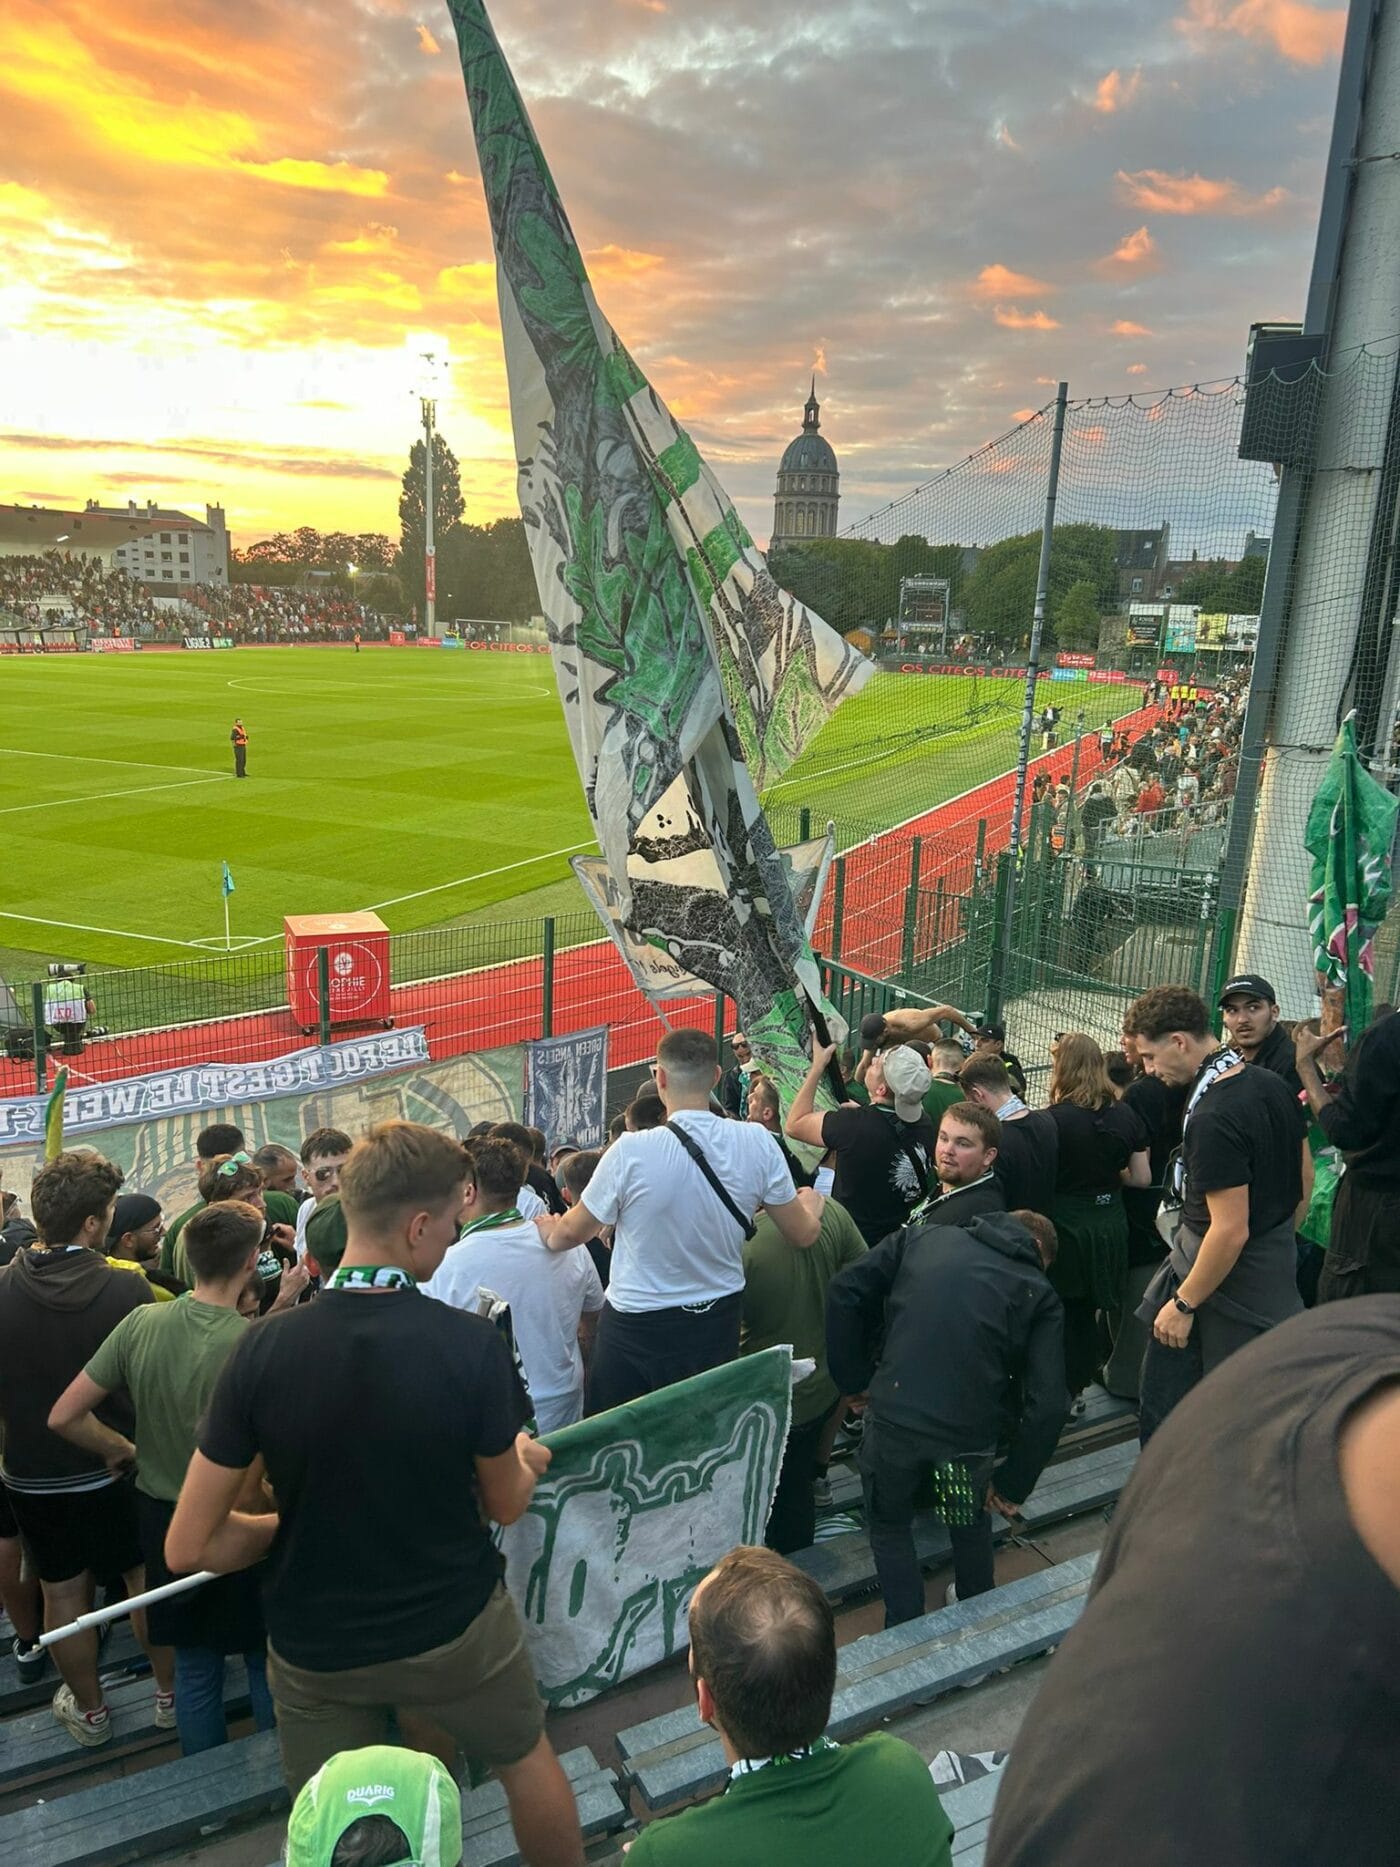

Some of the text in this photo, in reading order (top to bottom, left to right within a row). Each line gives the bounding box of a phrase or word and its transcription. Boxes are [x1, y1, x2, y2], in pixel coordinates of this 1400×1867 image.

[490, 641, 534, 652] CITEOS
[901, 663, 923, 673] OS
[928, 664, 986, 676] CITEOS
[328, 976, 366, 989] OPHIE
[347, 1784, 395, 1801] DUARIG
